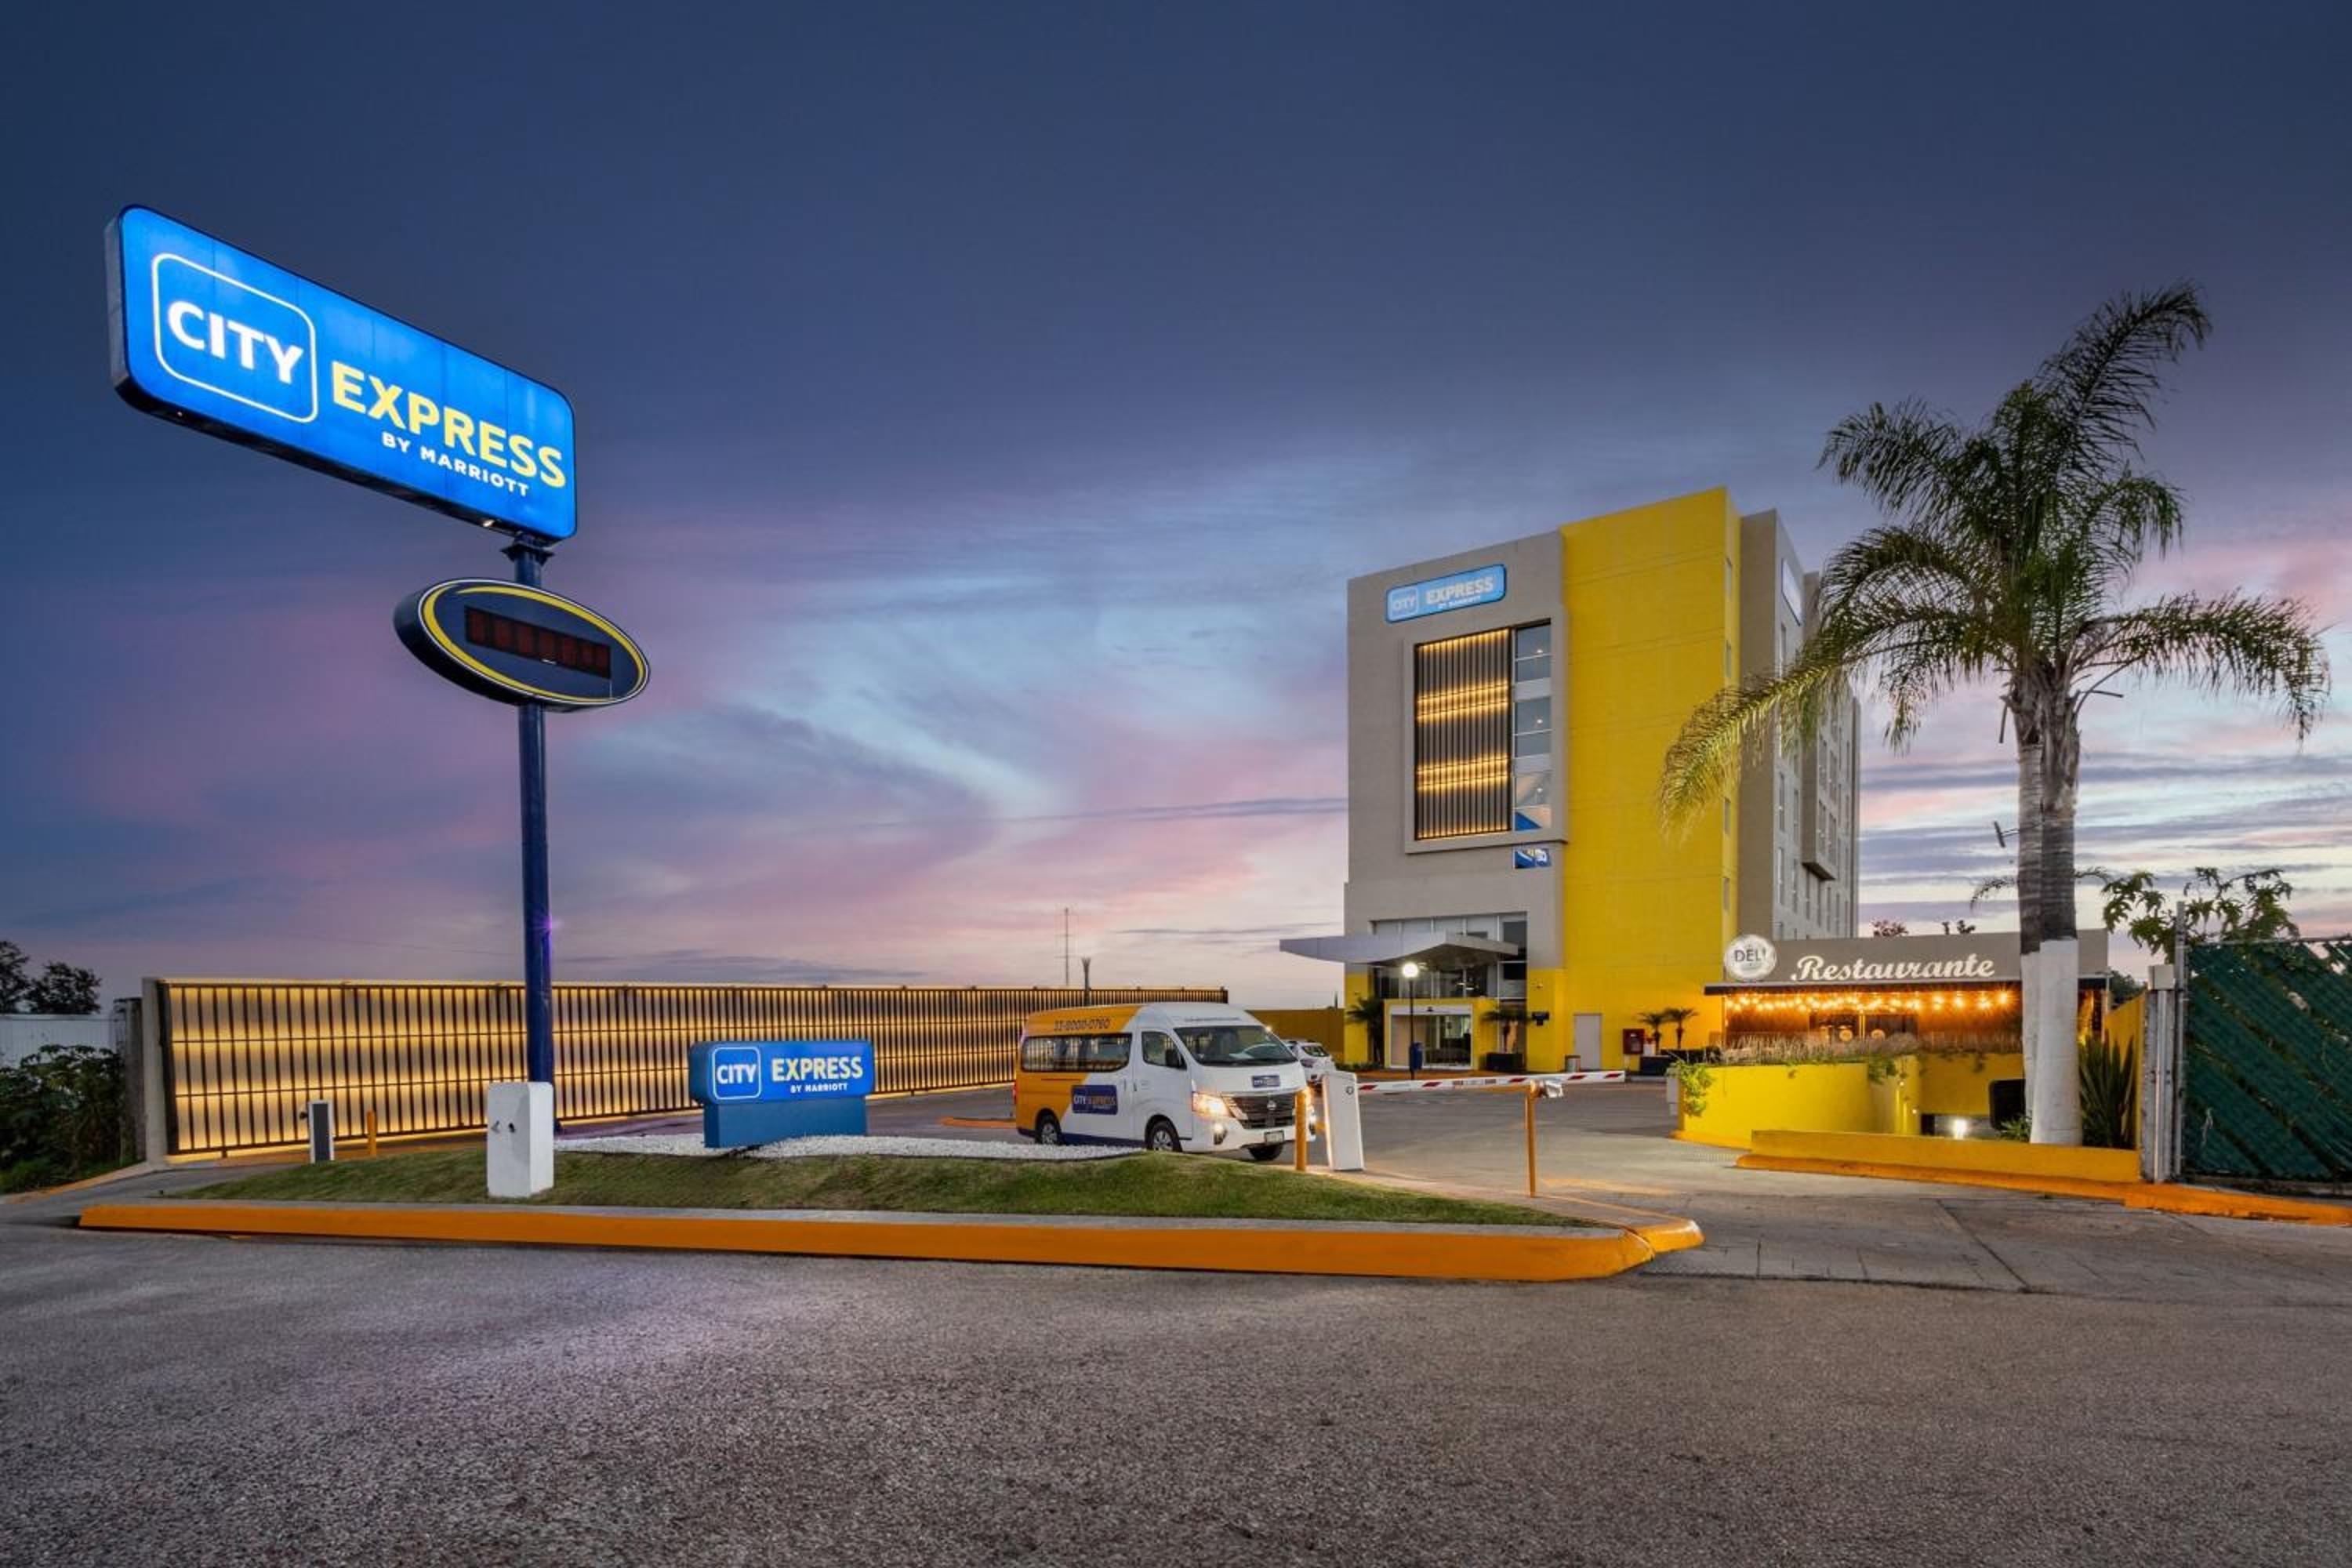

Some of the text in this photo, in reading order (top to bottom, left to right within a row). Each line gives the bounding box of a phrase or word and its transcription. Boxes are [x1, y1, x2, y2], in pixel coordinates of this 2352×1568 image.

[168, 300, 566, 488] CITY EXPRESS
[382, 431, 529, 497] BY MARRIOTT
[1426, 575, 1494, 604] EXPRESS
[1791, 953, 1995, 981] Restaurante
[717, 1056, 864, 1084] CITY EXPRESS
[790, 1082, 849, 1094] BY MARRIOTT
